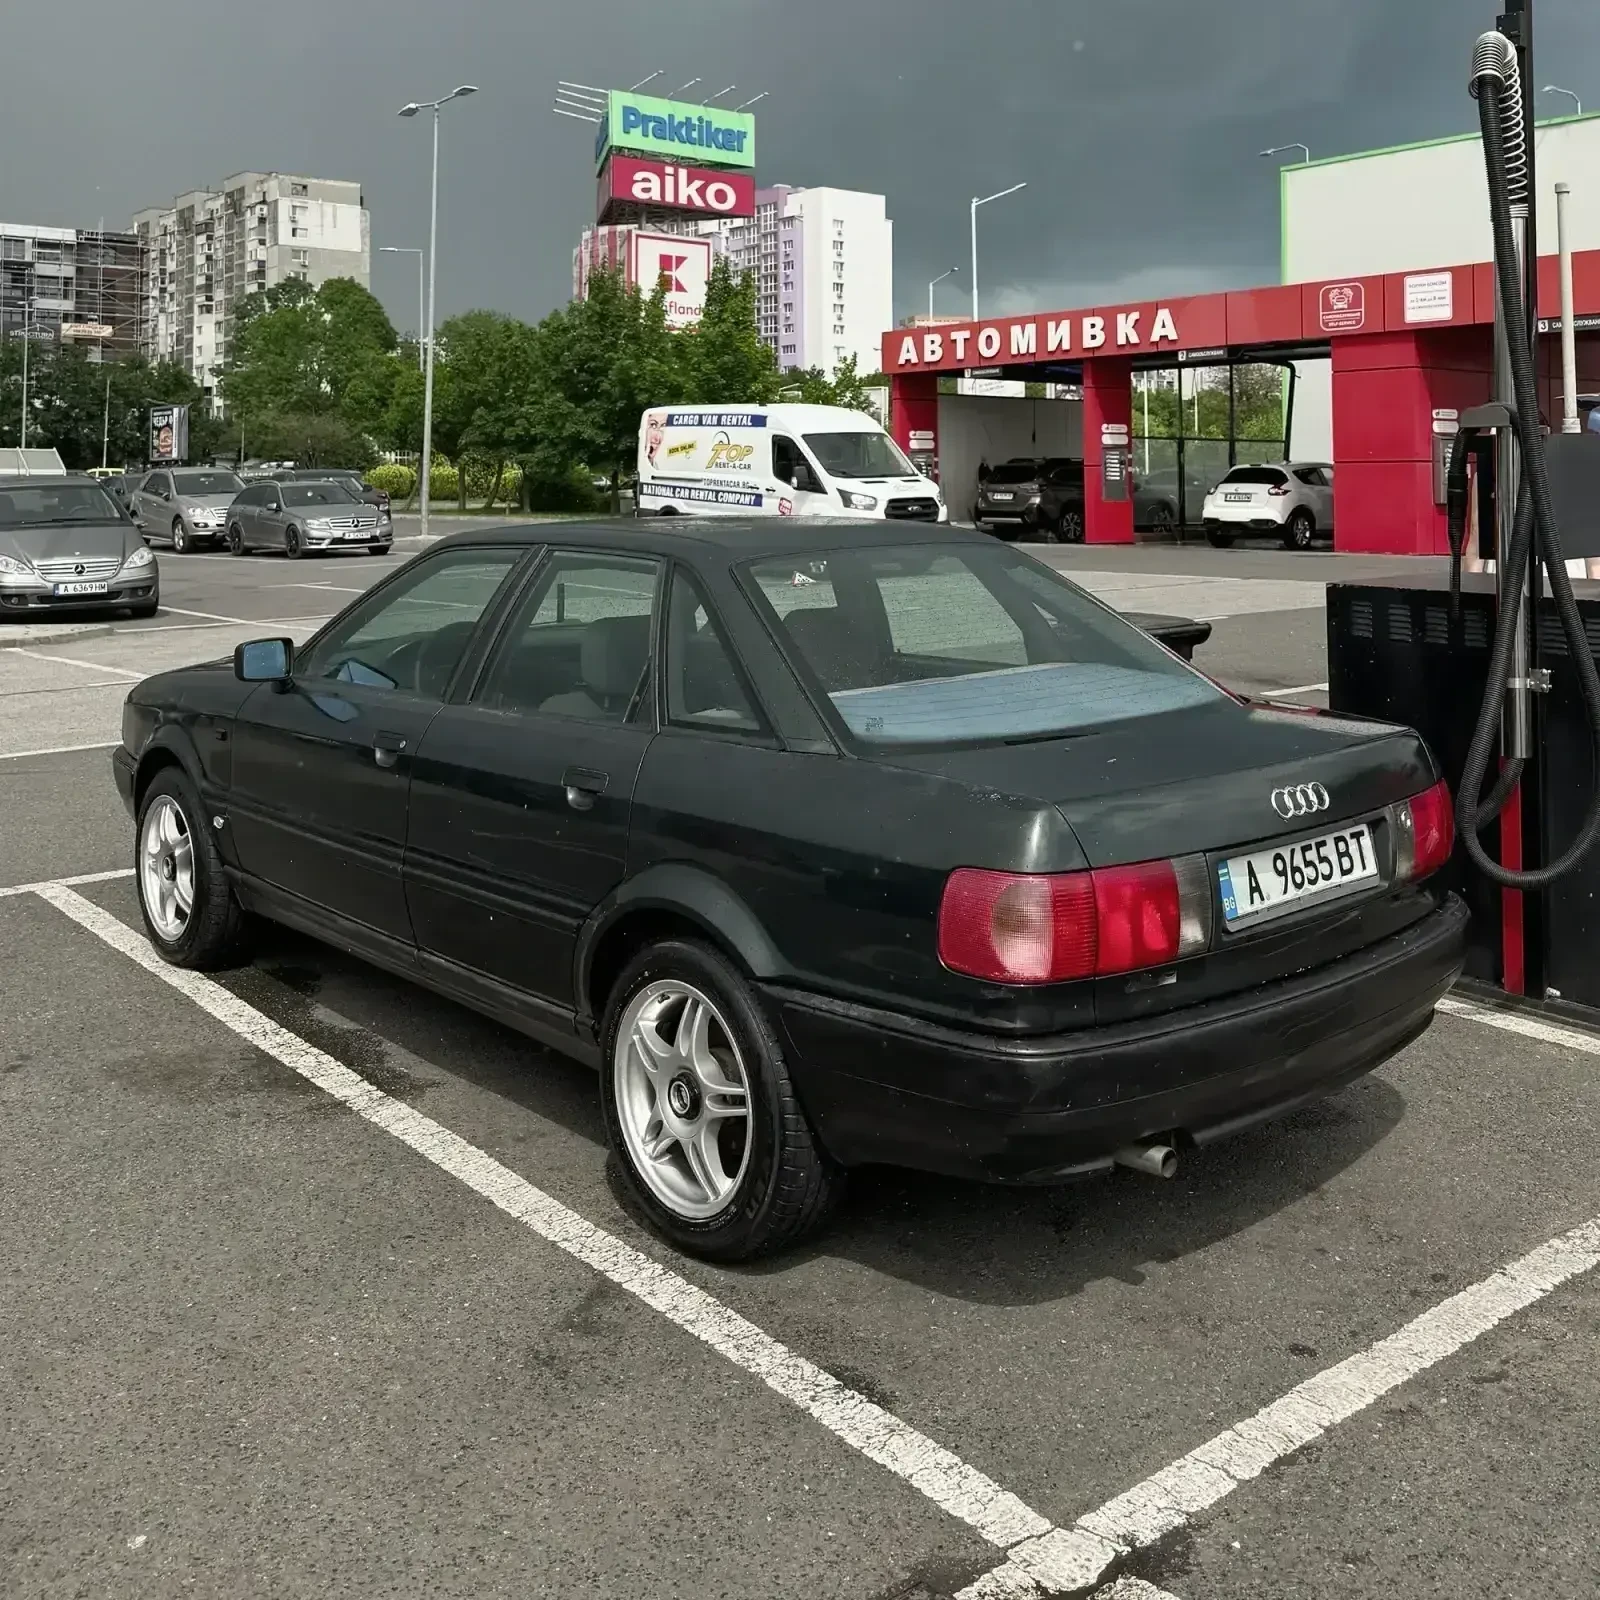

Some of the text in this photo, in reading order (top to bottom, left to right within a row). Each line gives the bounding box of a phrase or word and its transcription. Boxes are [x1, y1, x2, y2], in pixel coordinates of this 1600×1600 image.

[622, 105, 747, 153] Praktiker
[631, 166, 737, 211] aiko
[662, 300, 702, 316] fland
[1540, 321, 1547, 330] 3
[898, 308, 1179, 365] АВТОМИВКА
[673, 414, 752, 426] CARGO VAN RENTAL
[705, 444, 754, 469] TOP
[714, 462, 752, 470] RENT-A-CAR
[643, 485, 756, 505] NATIONAL CAR RENTAL COMPANY
[1247, 860, 1265, 905] A
[1223, 896, 1236, 911] BG
